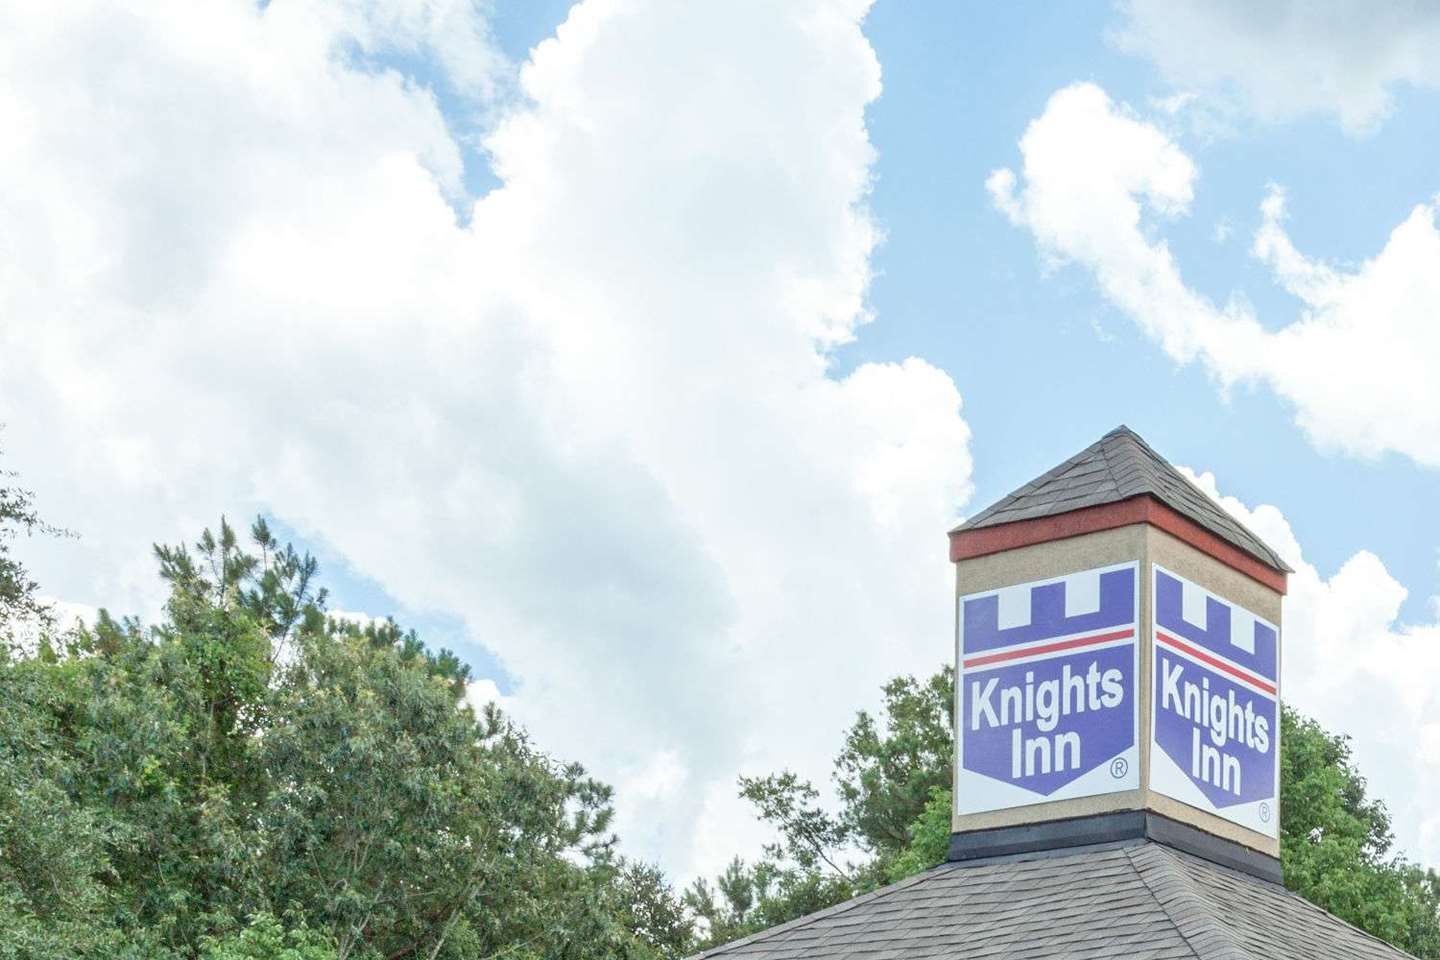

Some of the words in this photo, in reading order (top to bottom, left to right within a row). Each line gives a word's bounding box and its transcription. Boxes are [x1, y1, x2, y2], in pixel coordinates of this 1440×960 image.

[971, 660, 1124, 732] Knights
[1161, 658, 1270, 755] Knights
[1011, 729, 1081, 779] Inn
[1191, 727, 1241, 796] Inn
